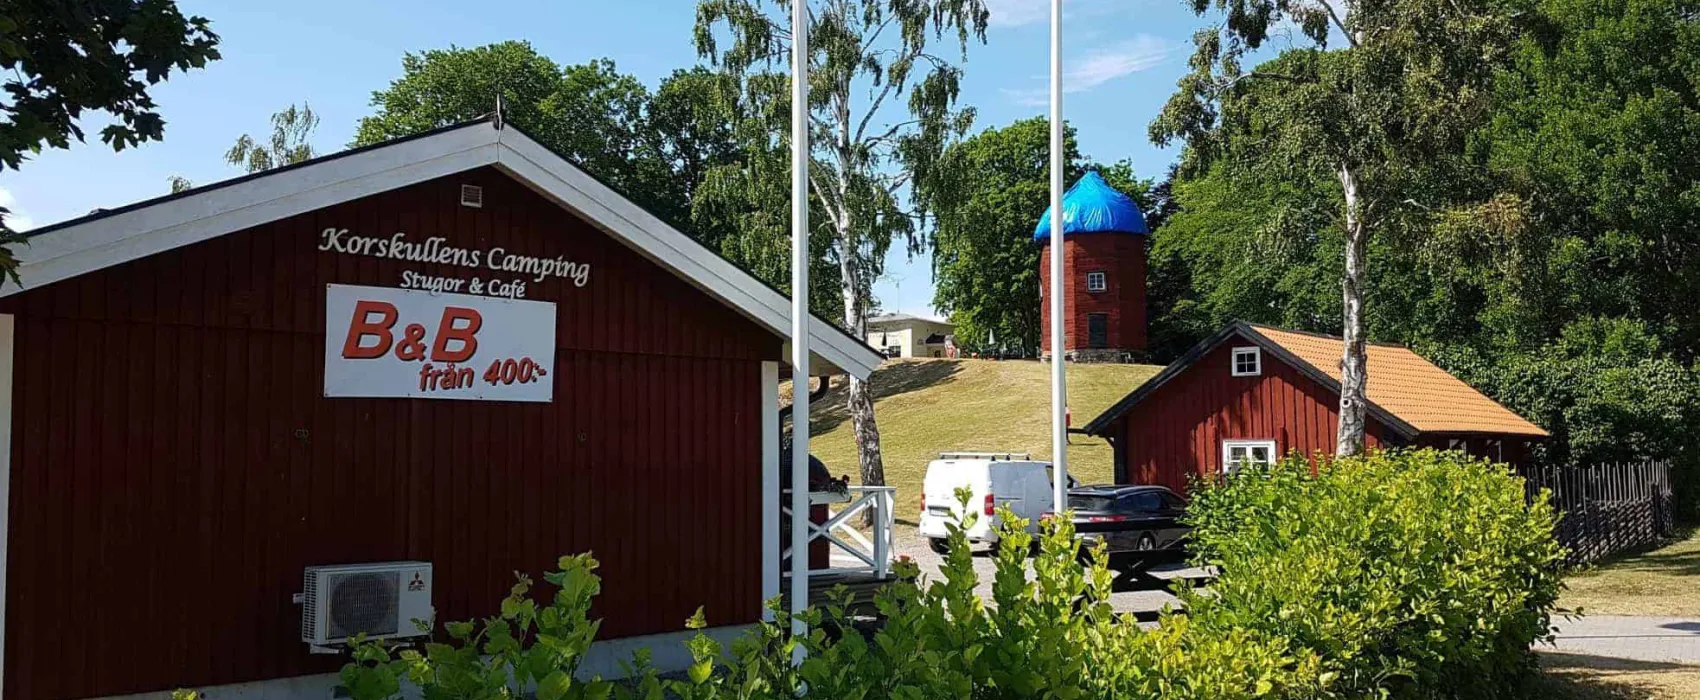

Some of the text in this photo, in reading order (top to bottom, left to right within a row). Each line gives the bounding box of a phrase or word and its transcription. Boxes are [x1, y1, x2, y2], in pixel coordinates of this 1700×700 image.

[318, 227, 590, 287] Korskullens Camping
[400, 270, 527, 301] Stugor & Café
[341, 299, 483, 363] B&B
[419, 361, 475, 392] från
